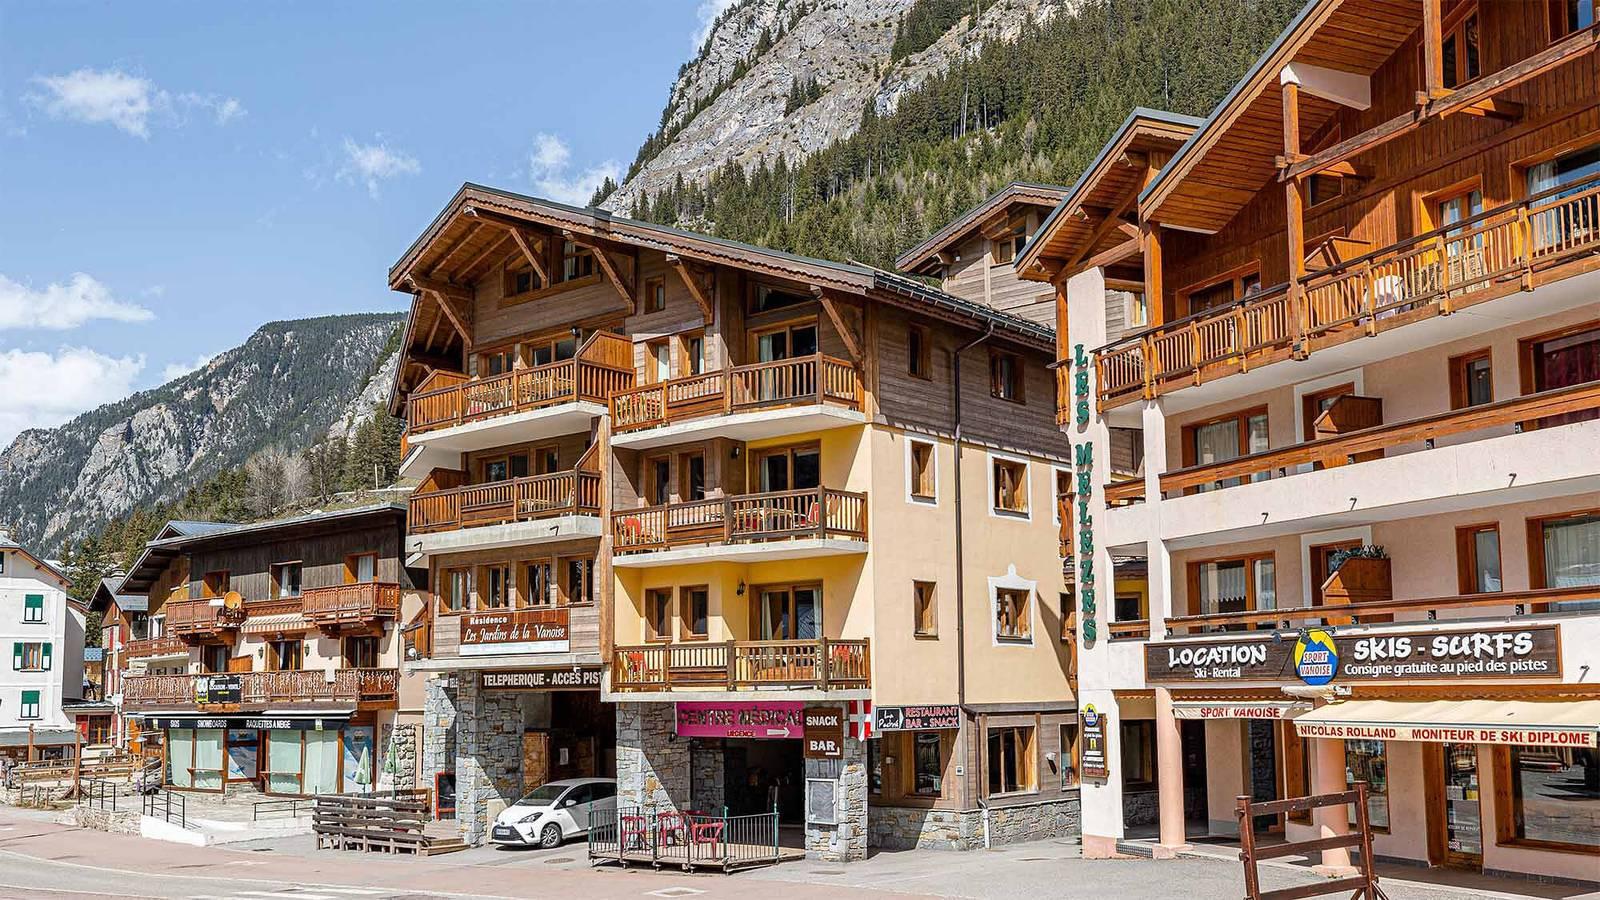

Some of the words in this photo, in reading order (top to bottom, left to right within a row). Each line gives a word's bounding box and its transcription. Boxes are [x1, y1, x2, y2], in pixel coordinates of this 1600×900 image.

[1074, 344, 1090, 425] LES
[1075, 441, 1097, 641] MELEZES
[470, 616, 508, 625] Résidence
[464, 628, 477, 643] Les
[480, 624, 508, 643] Jardins
[510, 623, 519, 640] de
[522, 623, 530, 639] la
[535, 624, 565, 639] Vanoise
[1354, 637, 1412, 661] SKIS
[1431, 632, 1533, 659] SURFS
[1168, 644, 1267, 668] LOCATION
[1304, 652, 1327, 662] SPORT
[1301, 665, 1330, 675] VANOISE
[1344, 662, 1392, 678] Consigne
[1394, 661, 1438, 677] gratuite
[1440, 663, 1455, 673] au
[1457, 660, 1484, 676] pied
[1486, 659, 1507, 672] des
[1510, 658, 1548, 675] pistes
[483, 673, 545, 687] TELEPHERIQUE
[681, 709, 734, 726] CENTRE
[905, 706, 958, 718] RESTAURANT
[1200, 707, 1229, 718] SPORT
[1233, 707, 1281, 718] VANOISE
[197, 719, 227, 728] SNOWBOARDS
[246, 719, 272, 729] RAQUETTES
[277, 719, 291, 729] NEIGE
[806, 716, 838, 726] SNACK
[905, 719, 922, 729] BAR
[929, 717, 958, 728] SNACK
[1300, 725, 1343, 737] NICOLAS
[1346, 727, 1397, 738] ROLLAND
[1412, 728, 1475, 741] MONITEUR
[1480, 730, 1497, 741] DE
[1501, 730, 1523, 742] SKI
[1528, 731, 1590, 745] DIPLOME
[810, 740, 835, 751] BAR
